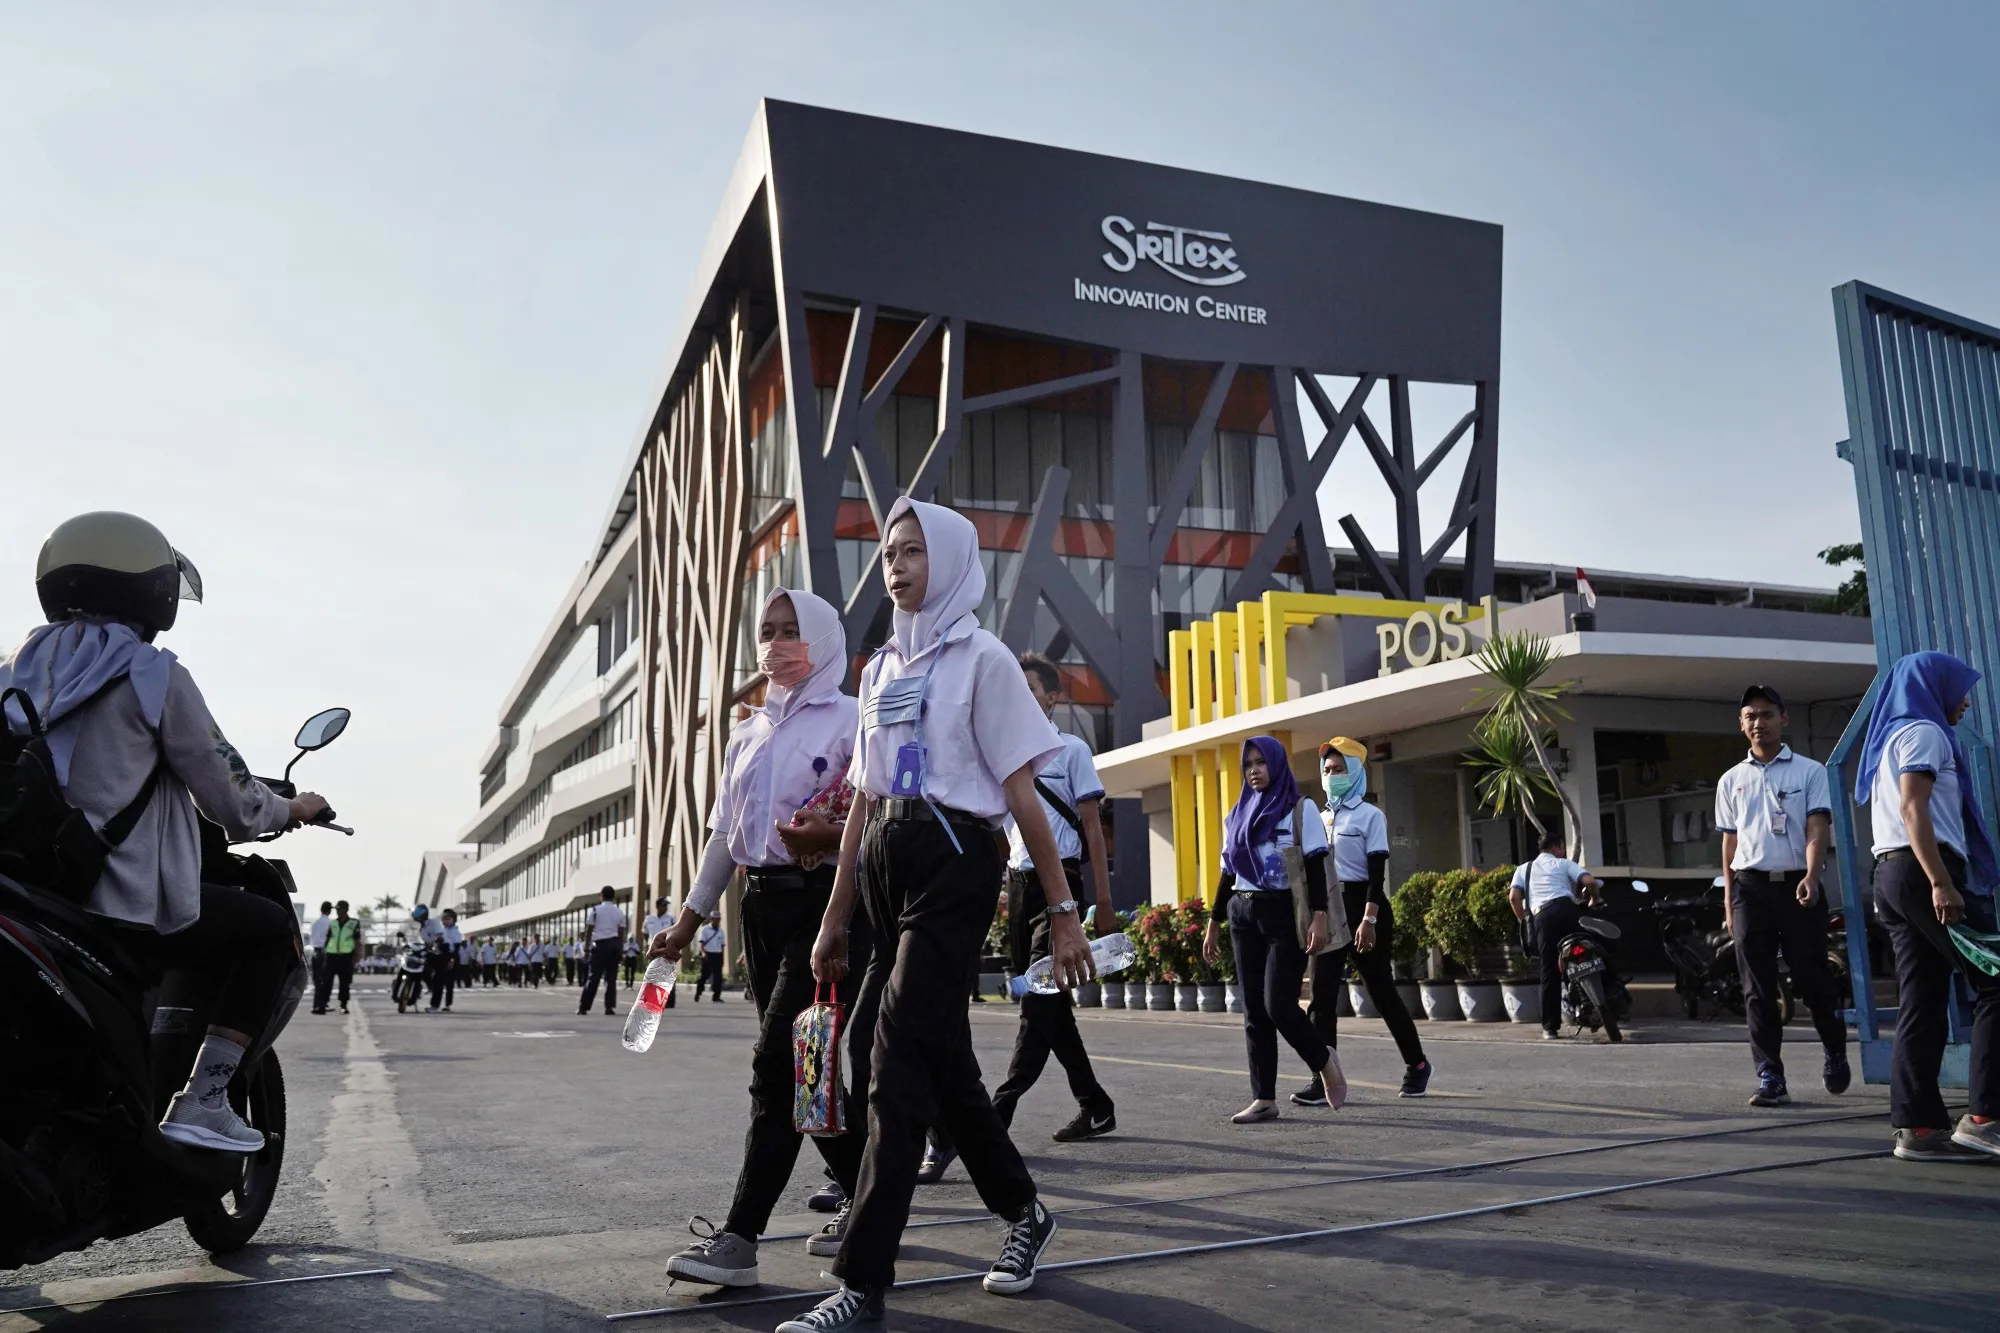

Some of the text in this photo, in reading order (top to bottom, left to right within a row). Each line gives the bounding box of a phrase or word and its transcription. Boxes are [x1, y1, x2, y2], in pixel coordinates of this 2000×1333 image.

[1074, 278, 1267, 325] INNOVATION CENTER
[1376, 601, 1472, 678] POS
